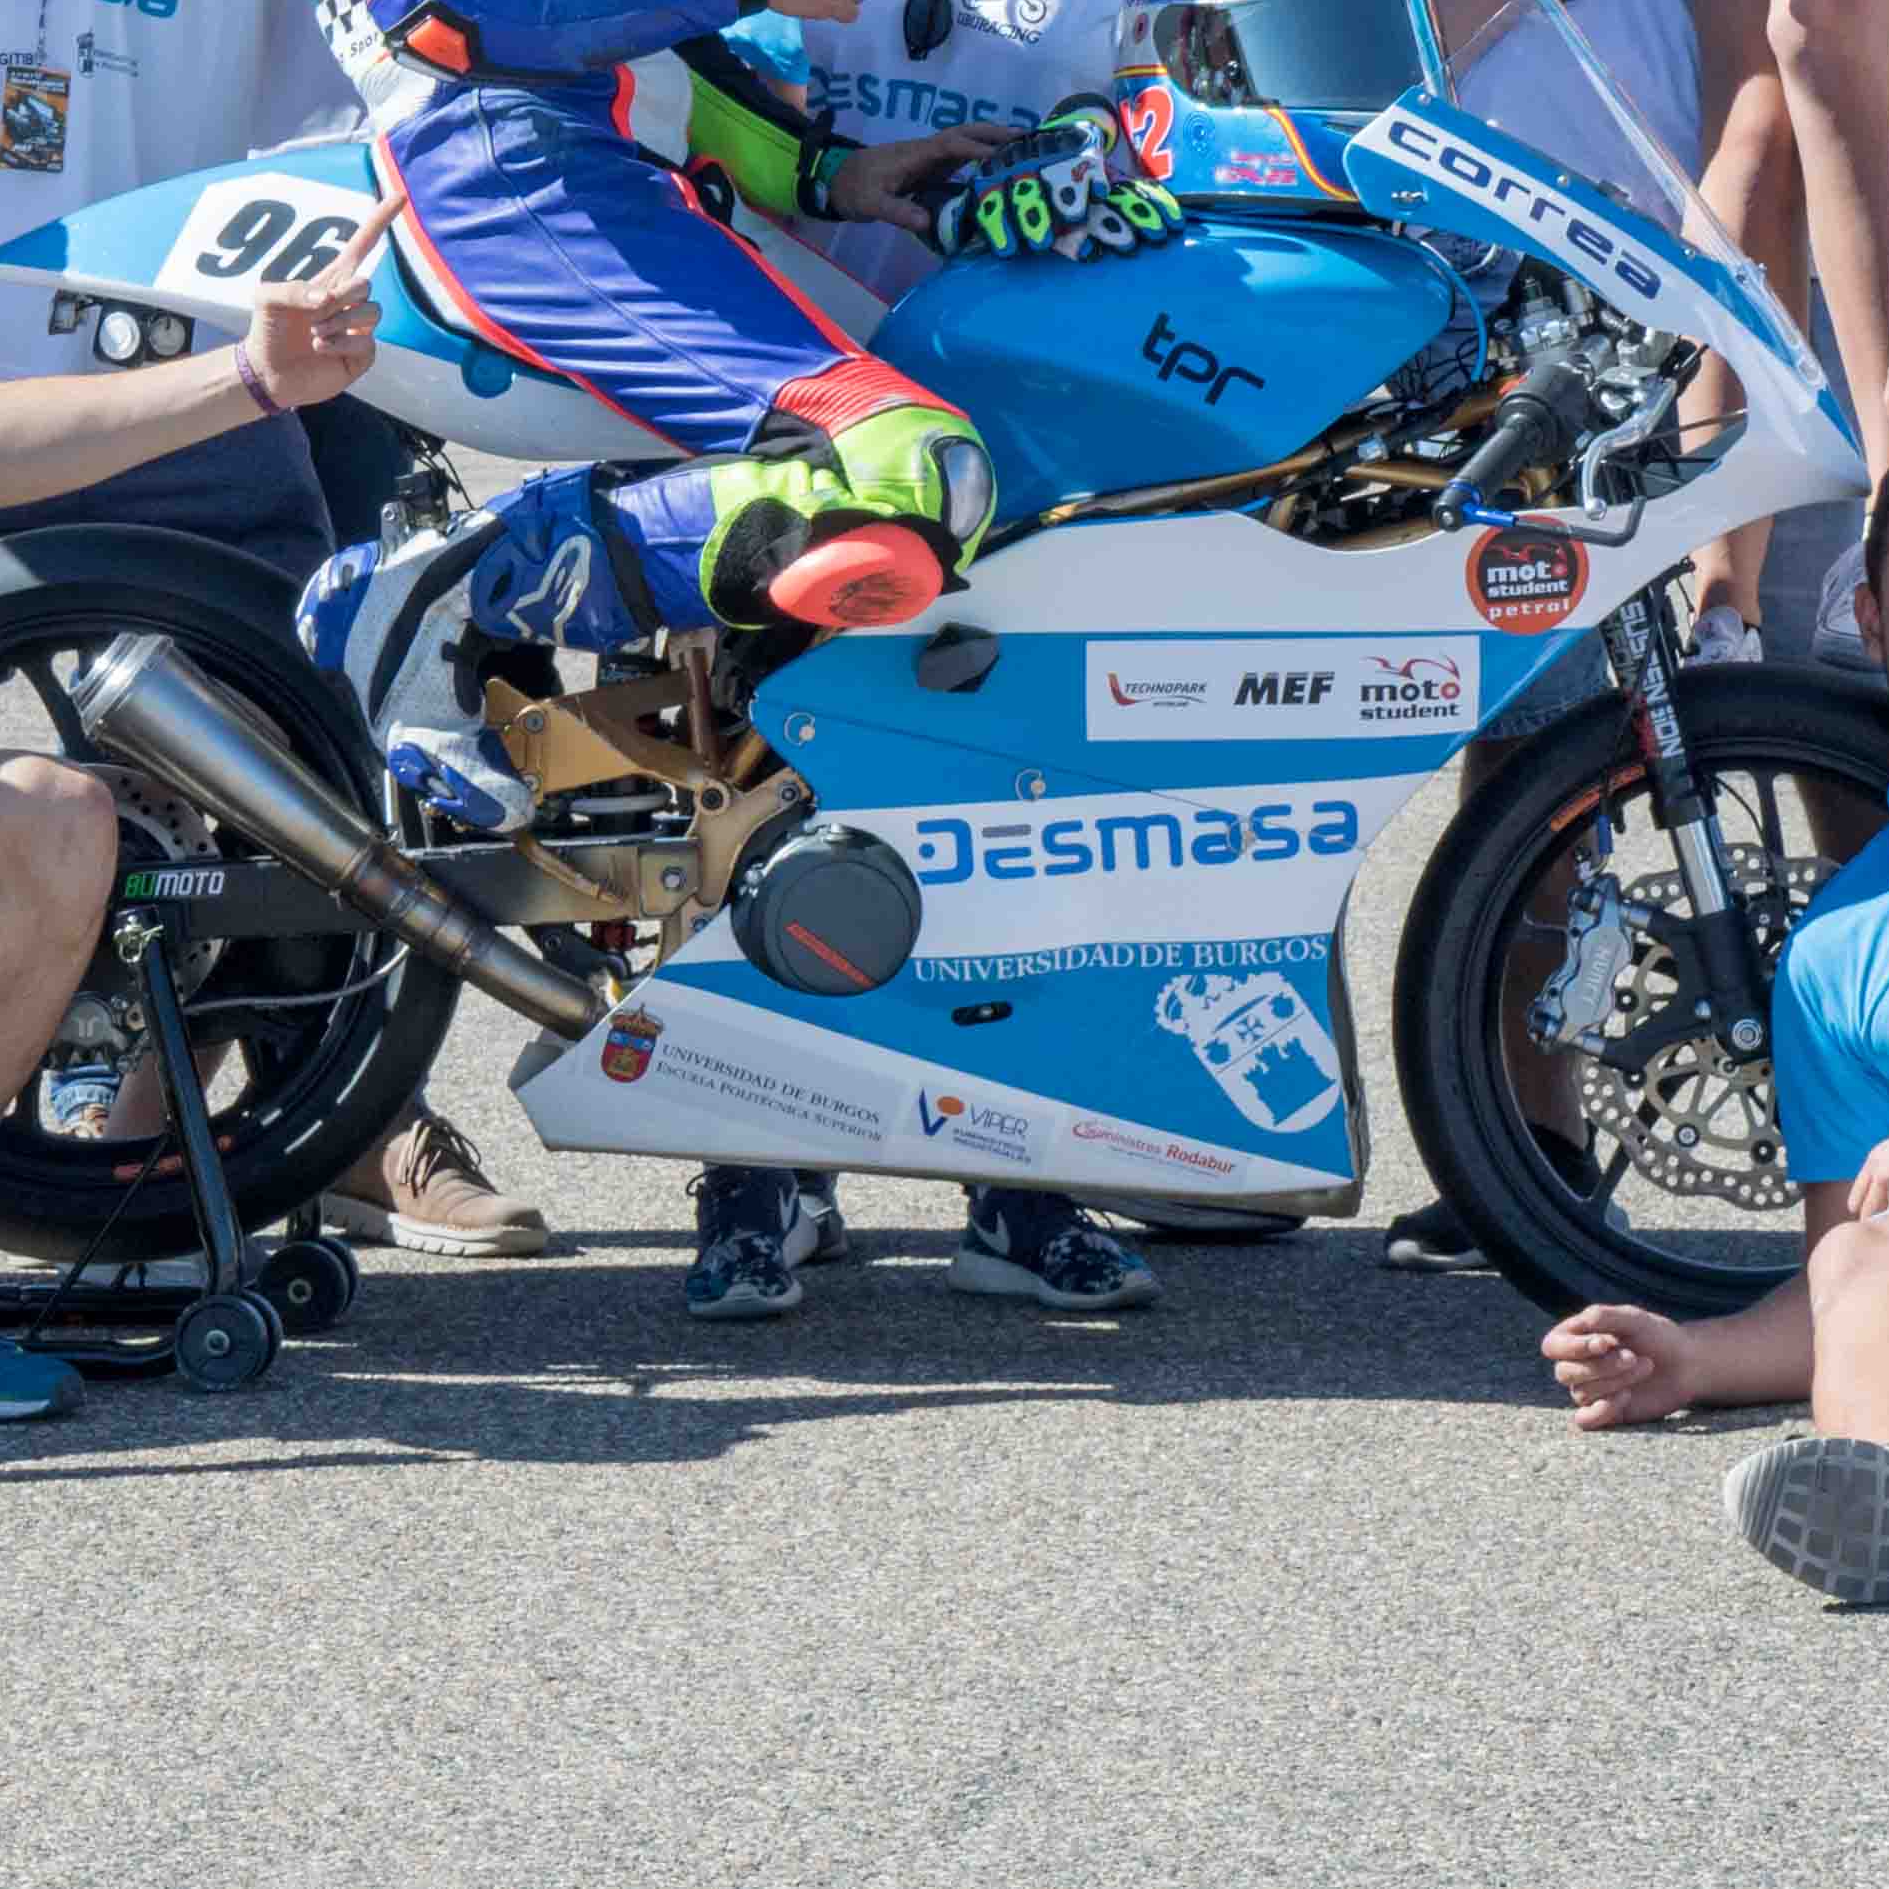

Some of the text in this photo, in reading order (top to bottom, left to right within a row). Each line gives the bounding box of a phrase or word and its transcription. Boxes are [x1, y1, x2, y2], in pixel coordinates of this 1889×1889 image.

[1387, 118, 1663, 301] correa
[195, 198, 359, 281] 96
[1486, 559, 1569, 585] moto
[1486, 579, 1569, 599] student
[1488, 597, 1571, 622] petrol
[1233, 671, 1335, 706] MEF
[1360, 677, 1461, 703] moto
[1359, 702, 1461, 721] student
[914, 934, 1328, 983] UNIVERSIDAD DE BURGOS
[661, 1043, 881, 1126] UNIVERSIDAD DE BURGOS
[969, 1101, 1030, 1139] VIPER
[1165, 1142, 1237, 1175] Rodabur
